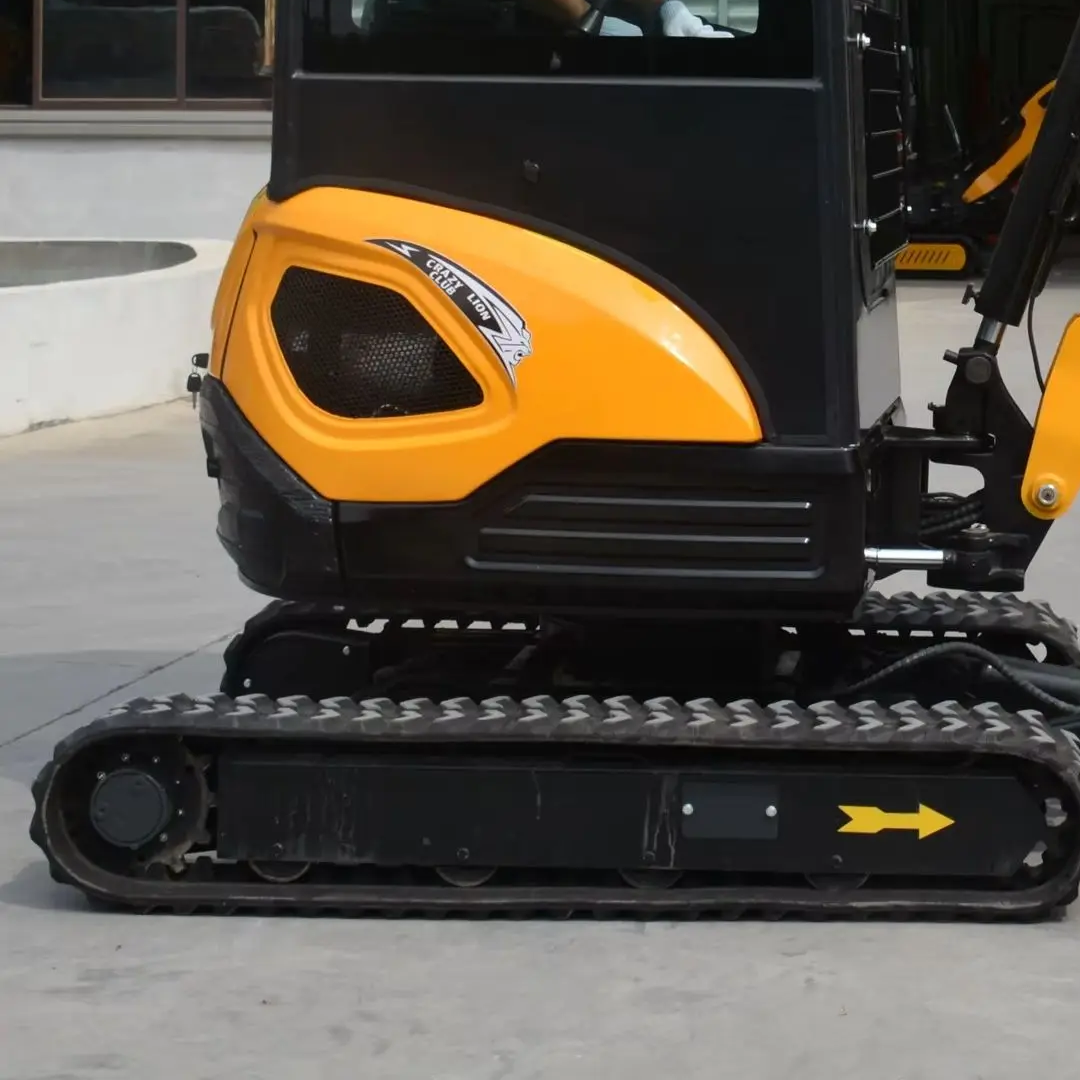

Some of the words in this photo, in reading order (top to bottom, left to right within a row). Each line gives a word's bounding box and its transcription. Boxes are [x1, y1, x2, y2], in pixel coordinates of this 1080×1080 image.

[426, 260, 464, 289] CRAZY
[466, 293, 491, 321] LION
[429, 271, 456, 296] CLUB
